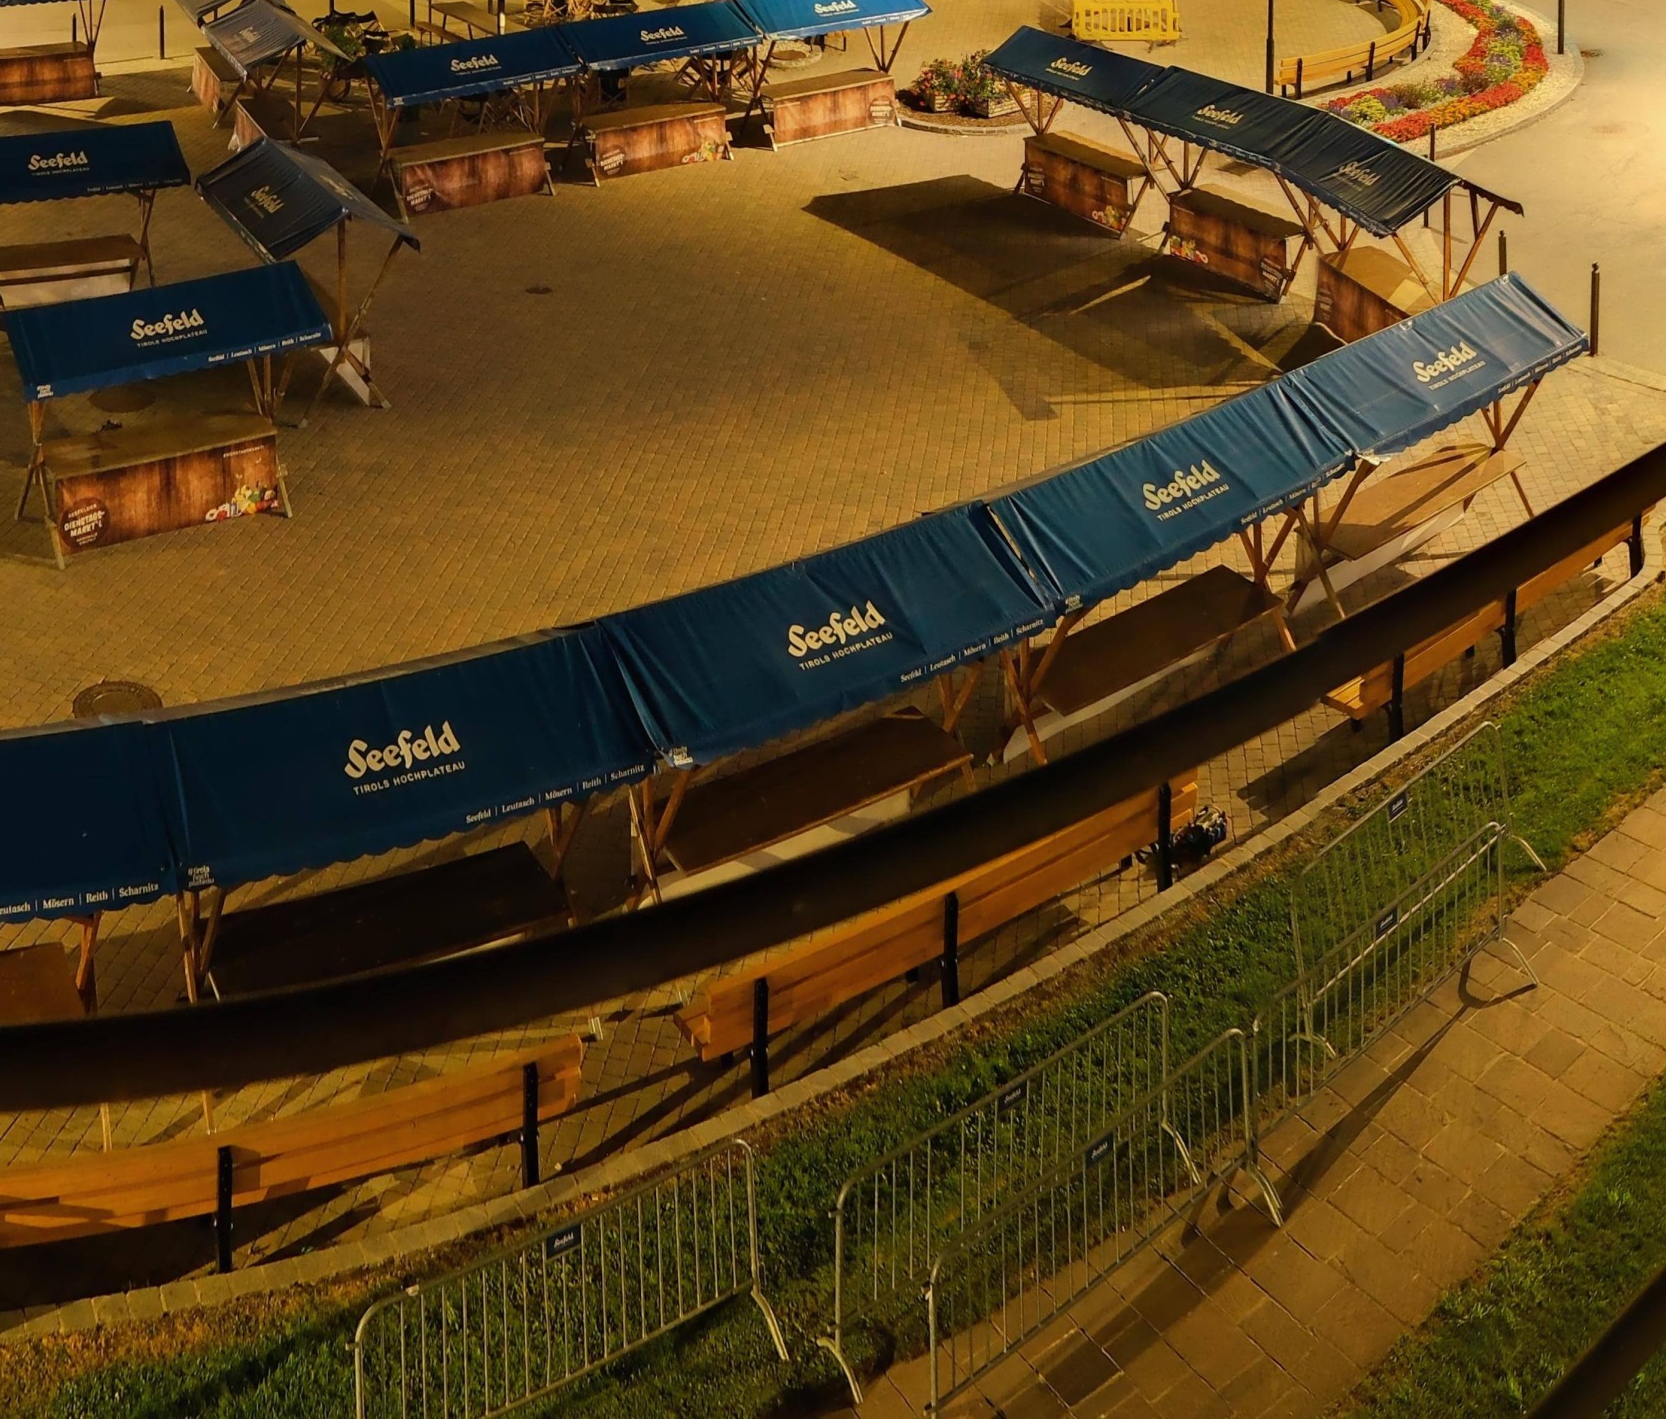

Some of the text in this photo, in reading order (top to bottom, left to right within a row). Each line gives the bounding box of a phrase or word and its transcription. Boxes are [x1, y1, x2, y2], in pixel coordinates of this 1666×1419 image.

[814, 0, 857, 14] Seefeld
[640, 26, 685, 42] Seefeld
[450, 54, 499, 72] Seefeld
[28, 150, 88, 170] Seefeld
[130, 308, 205, 340] Seefeld
[1413, 340, 1478, 383] Seefeld
[1142, 459, 1221, 511] Seefeld
[787, 599, 886, 658] Seefeld
[798, 654, 831, 671] TIROLS
[344, 719, 461, 779] Seefeld
[352, 760, 466, 796] TIROLS HOCHPLATEAU
[465, 763, 645, 824] Seefeld Leutasch Mösern Reith Scharnitz
[42, 896, 75, 909] Mösern
[85, 890, 109, 903] Reith
[118, 882, 160, 898] Scharnitz
